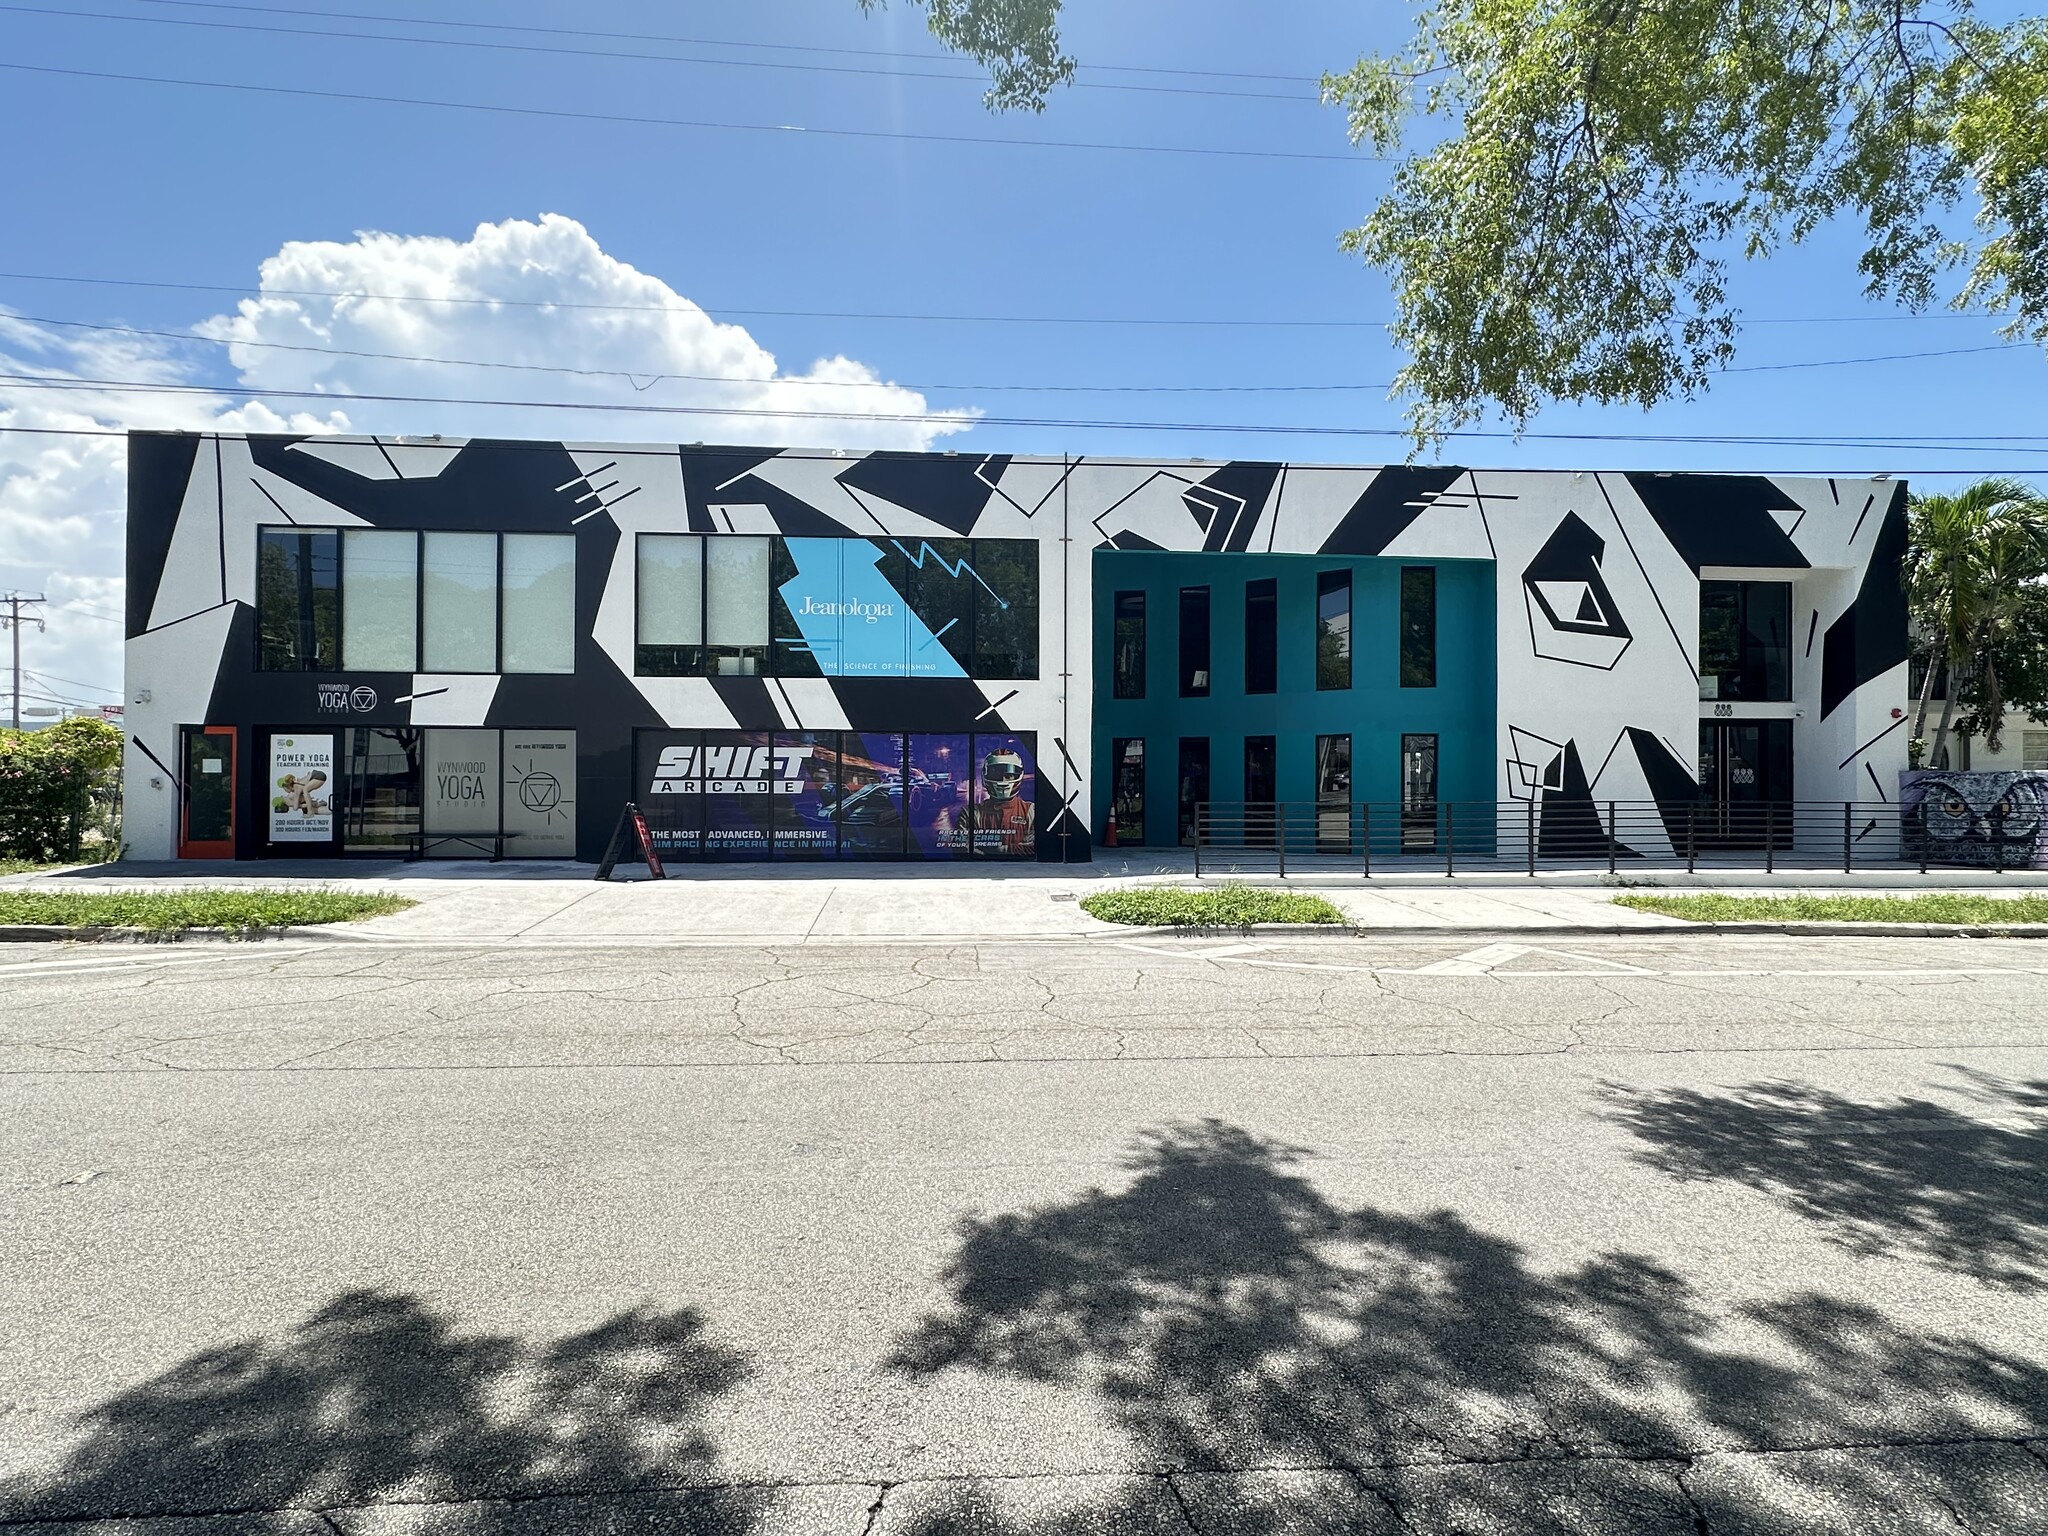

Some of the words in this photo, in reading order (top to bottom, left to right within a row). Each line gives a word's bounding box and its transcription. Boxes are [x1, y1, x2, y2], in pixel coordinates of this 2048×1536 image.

[799, 596, 894, 625] Jeanologia
[844, 662, 877, 670] SCIENCE
[881, 663, 892, 671] OF
[895, 663, 937, 671] FINISHING
[318, 684, 350, 692] WYNWOOD
[318, 692, 349, 709] YOGA
[276, 753, 305, 762] POWER
[309, 753, 330, 762] YOGA
[655, 746, 814, 778] SHIFT
[437, 761, 486, 773] WYNWOOD
[437, 775, 485, 800] YOGA
[660, 781, 795, 793] ARCADE
[437, 800, 486, 808] STUDIO
[650, 830, 669, 839] THE
[672, 830, 700, 839] MOST
[707, 830, 764, 840] ADVANCED,
[766, 830, 828, 839] IMMERSIVE
[653, 840, 671, 848] SIM
[673, 840, 720, 848] RACING
[723, 840, 796, 848] EXPERIENCE
[798, 840, 809, 848] IN
